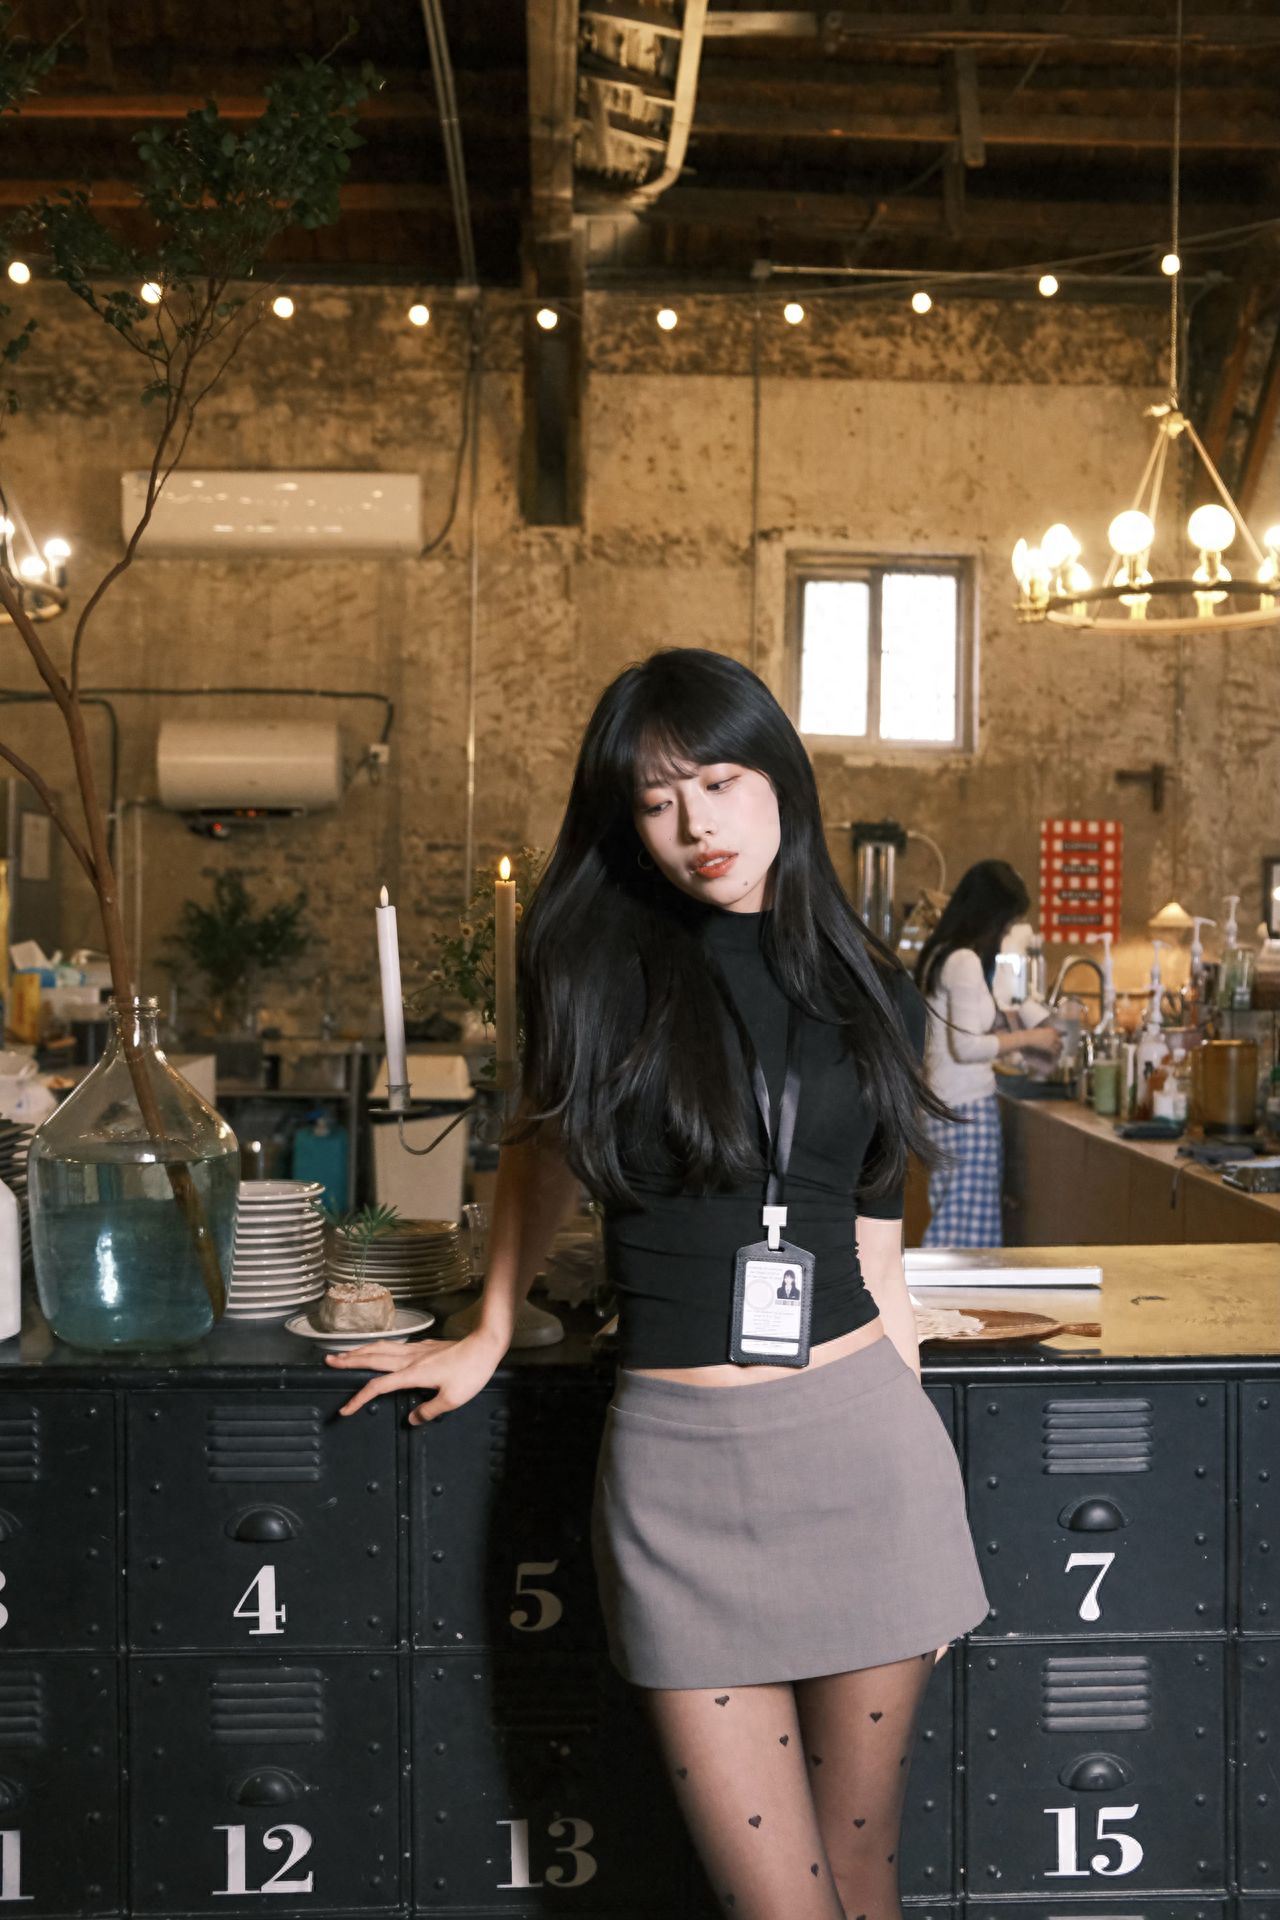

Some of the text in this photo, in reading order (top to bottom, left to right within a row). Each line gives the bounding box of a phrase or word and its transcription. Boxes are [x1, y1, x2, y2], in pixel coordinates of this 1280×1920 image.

[233, 1565, 286, 1634] 4
[510, 1560, 563, 1632] 5
[1065, 1553, 1115, 1621] 7
[213, 1824, 313, 1895] 12
[496, 1818, 597, 1888] 13
[1044, 1804, 1143, 1876] 15
